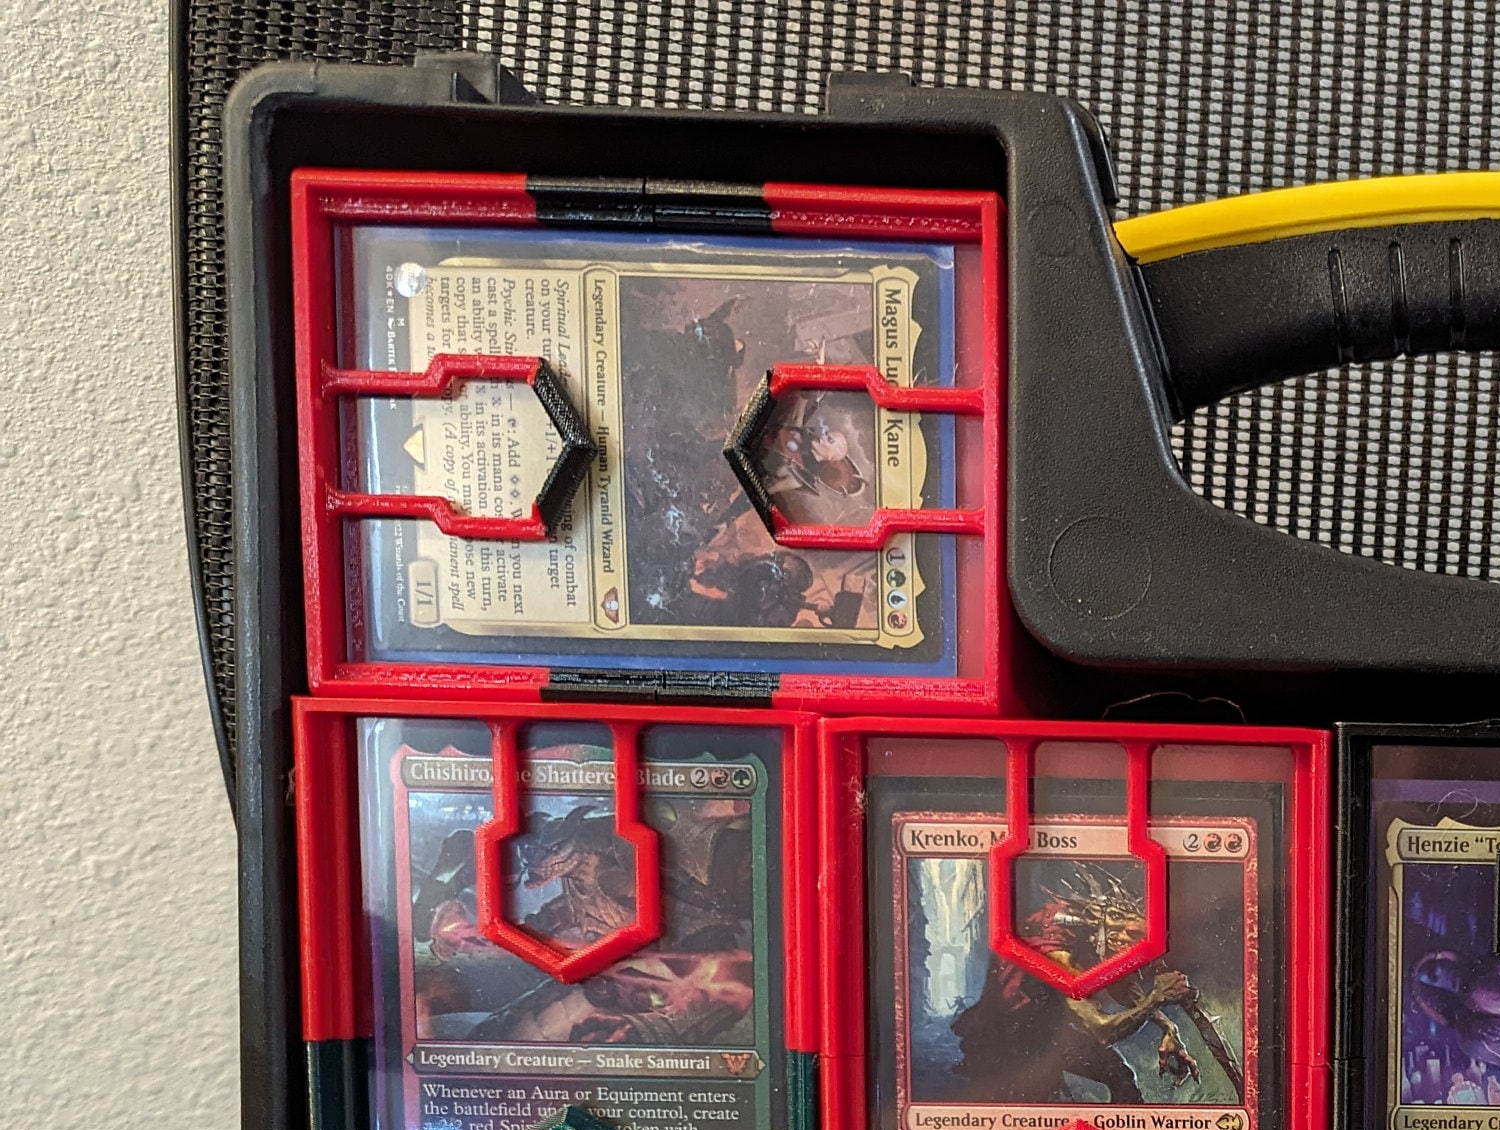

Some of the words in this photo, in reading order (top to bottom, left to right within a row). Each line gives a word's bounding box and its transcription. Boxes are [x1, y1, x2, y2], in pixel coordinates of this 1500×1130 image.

[424, 277, 438, 329] becomes
[438, 276, 453, 326] targets
[454, 277, 468, 312] copy
[487, 277, 500, 305] cast
[500, 277, 516, 327] Psychic
[469, 298, 486, 343] ability
[524, 278, 538, 340] creature.
[593, 278, 606, 347] Legendary
[882, 289, 902, 348] Magus
[440, 329, 455, 349] for
[457, 315, 470, 344] that
[595, 350, 607, 406] Creature
[886, 356, 903, 388] Luc
[458, 404, 474, 450] ability.
[476, 420, 488, 438] its
[491, 432, 504, 450] its
[556, 278, 571, 339] Spiritual
[564, 555, 578, 607] combat
[883, 418, 904, 467] Kane
[443, 444, 457, 476] copy
[507, 440, 520, 468] Add
[538, 301, 553, 334] your
[547, 549, 561, 589] target
[597, 426, 610, 472] Human
[460, 454, 474, 481] You
[476, 441, 490, 510] activation
[492, 453, 503, 492] mana
[596, 476, 612, 525] Tyranid
[480, 547, 493, 571] this
[509, 552, 523, 579] you
[601, 528, 614, 573] Wizard
[465, 571, 477, 600] new
[496, 549, 509, 602] activate
[415, 580, 433, 608] 1/1
[447, 582, 463, 611] spell
[479, 576, 494, 612] turn,
[513, 583, 524, 616] next
[536, 762, 615, 785] Shattere
[910, 829, 985, 850] Krenko,
[1037, 831, 1078, 849] Boss
[1407, 835, 1470, 855] Henzie
[420, 1052, 501, 1069] Legendary
[506, 1054, 574, 1068] Creature
[596, 1055, 643, 1069] Snake
[647, 1056, 711, 1070] Samurai
[423, 1083, 503, 1100] Whenever
[532, 1085, 570, 1100] Aura
[597, 1086, 685, 1105] Equipment
[689, 1090, 737, 1104] enters
[424, 1102, 449, 1116] the
[454, 1102, 532, 1117] battlefield
[628, 1106, 688, 1121] control,
[693, 1108, 740, 1121] create
[916, 1112, 997, 1130] Legendary
[1001, 1114, 1070, 1128] Creature
[1093, 1115, 1146, 1130] Goblin
[1150, 1116, 1212, 1130] Warrior
